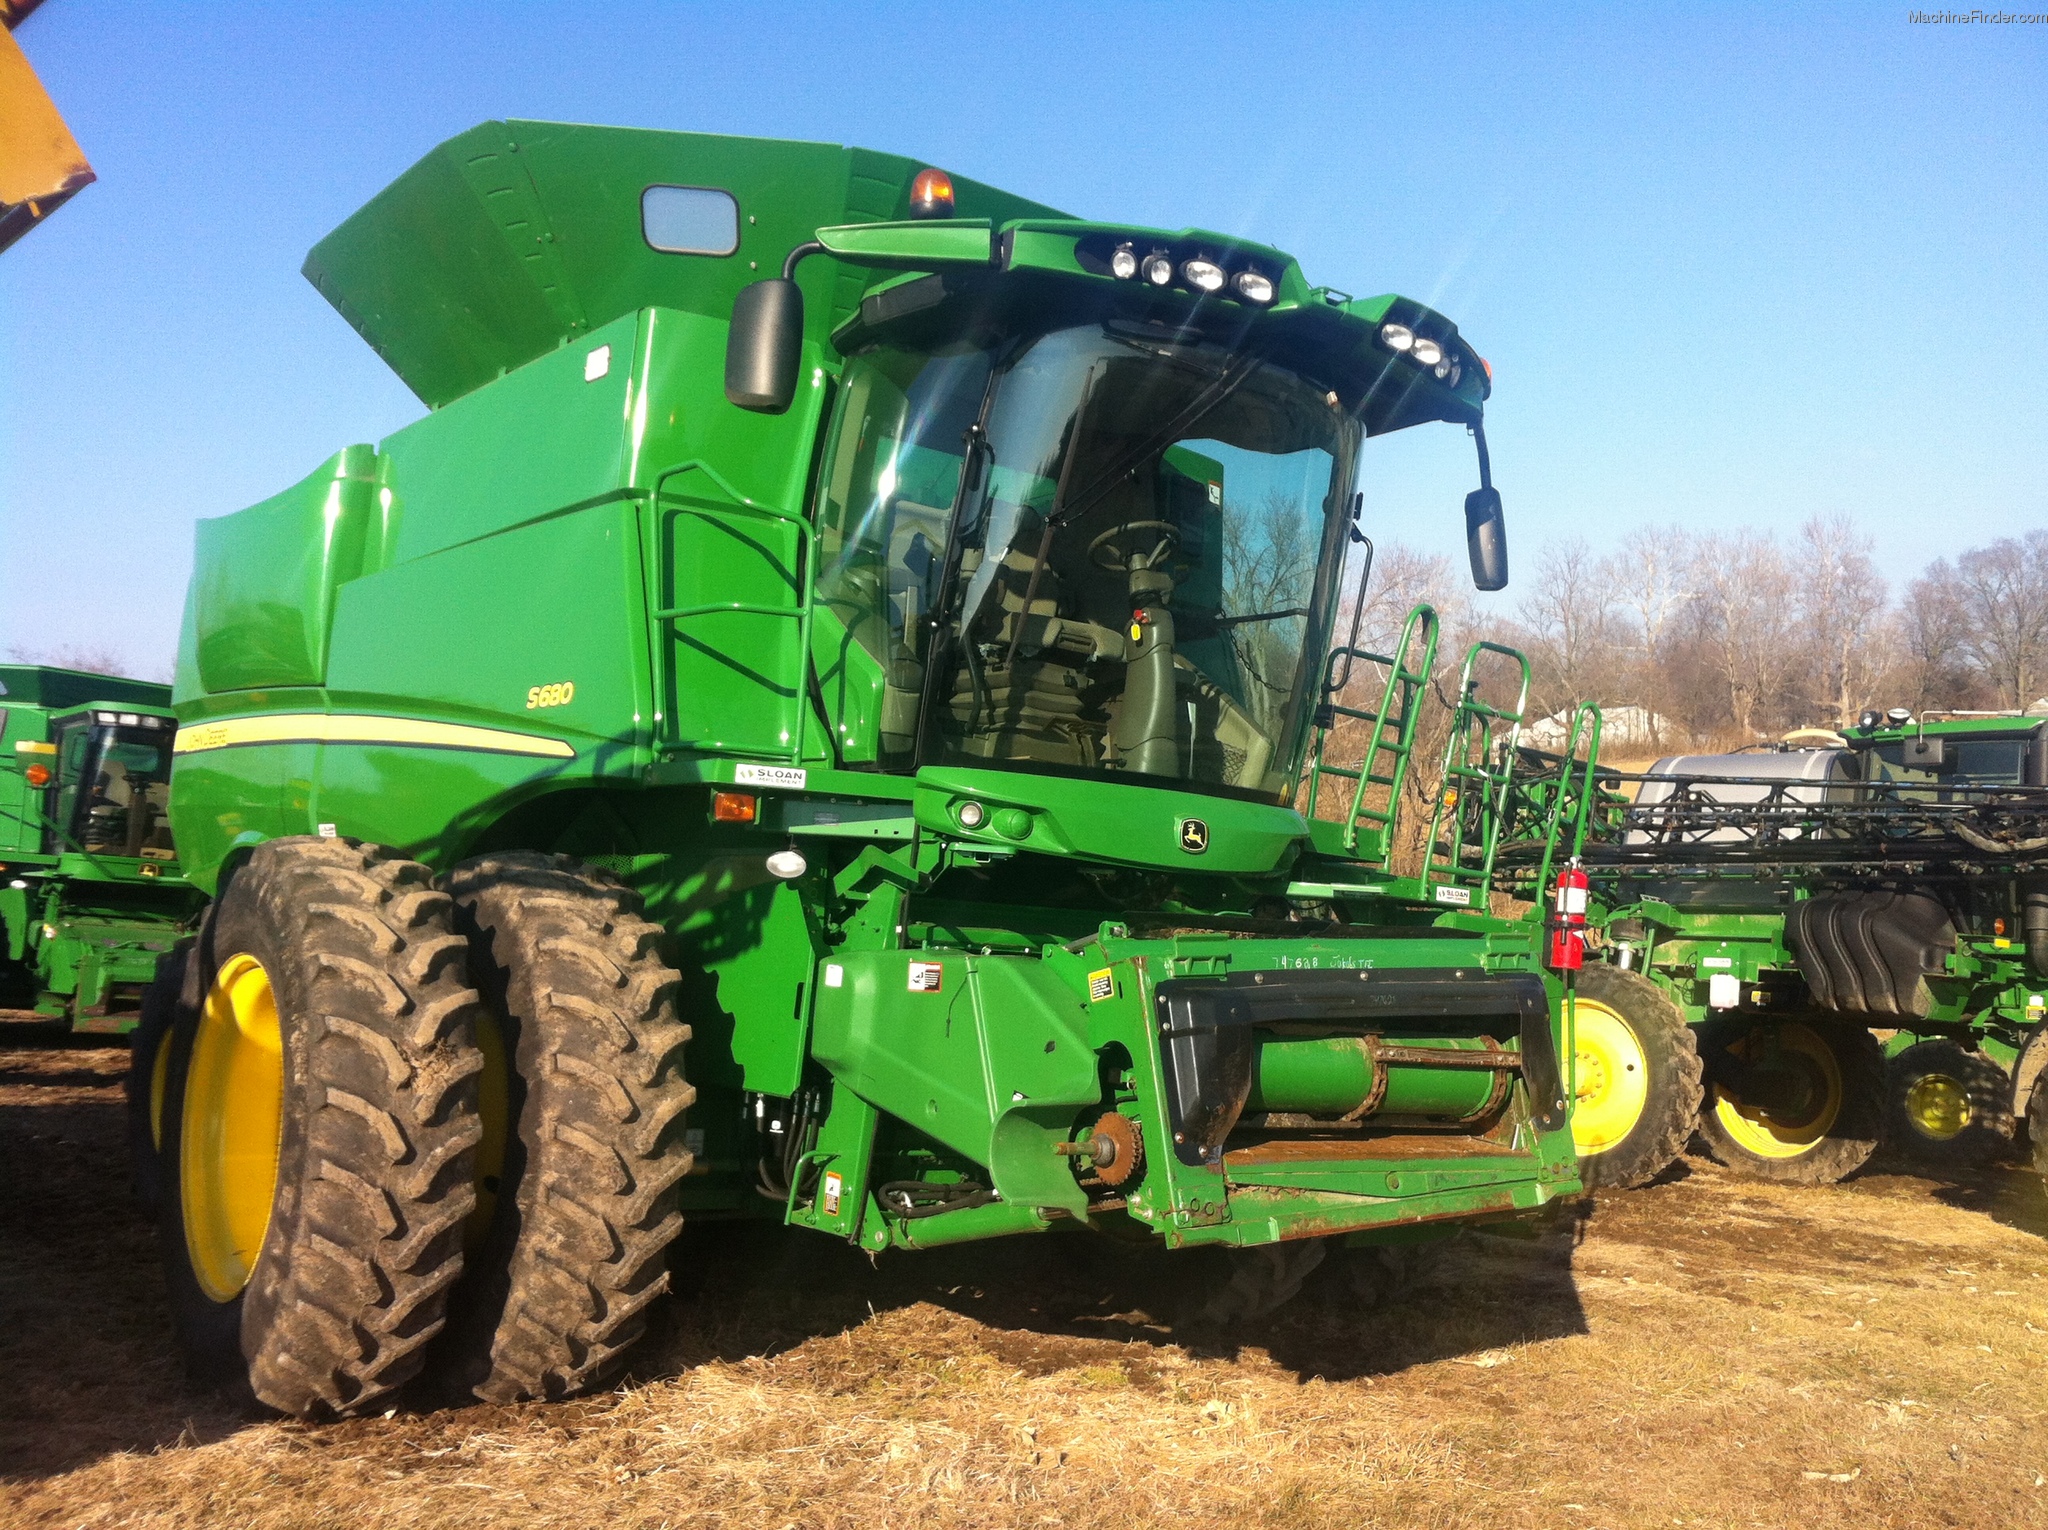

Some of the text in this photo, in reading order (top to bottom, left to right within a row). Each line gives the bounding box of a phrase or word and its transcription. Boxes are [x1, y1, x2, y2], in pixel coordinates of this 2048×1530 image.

[526, 681, 575, 710] S680
[757, 769, 803, 780] SLOAN
[1446, 889, 1469, 898] SLOAN
